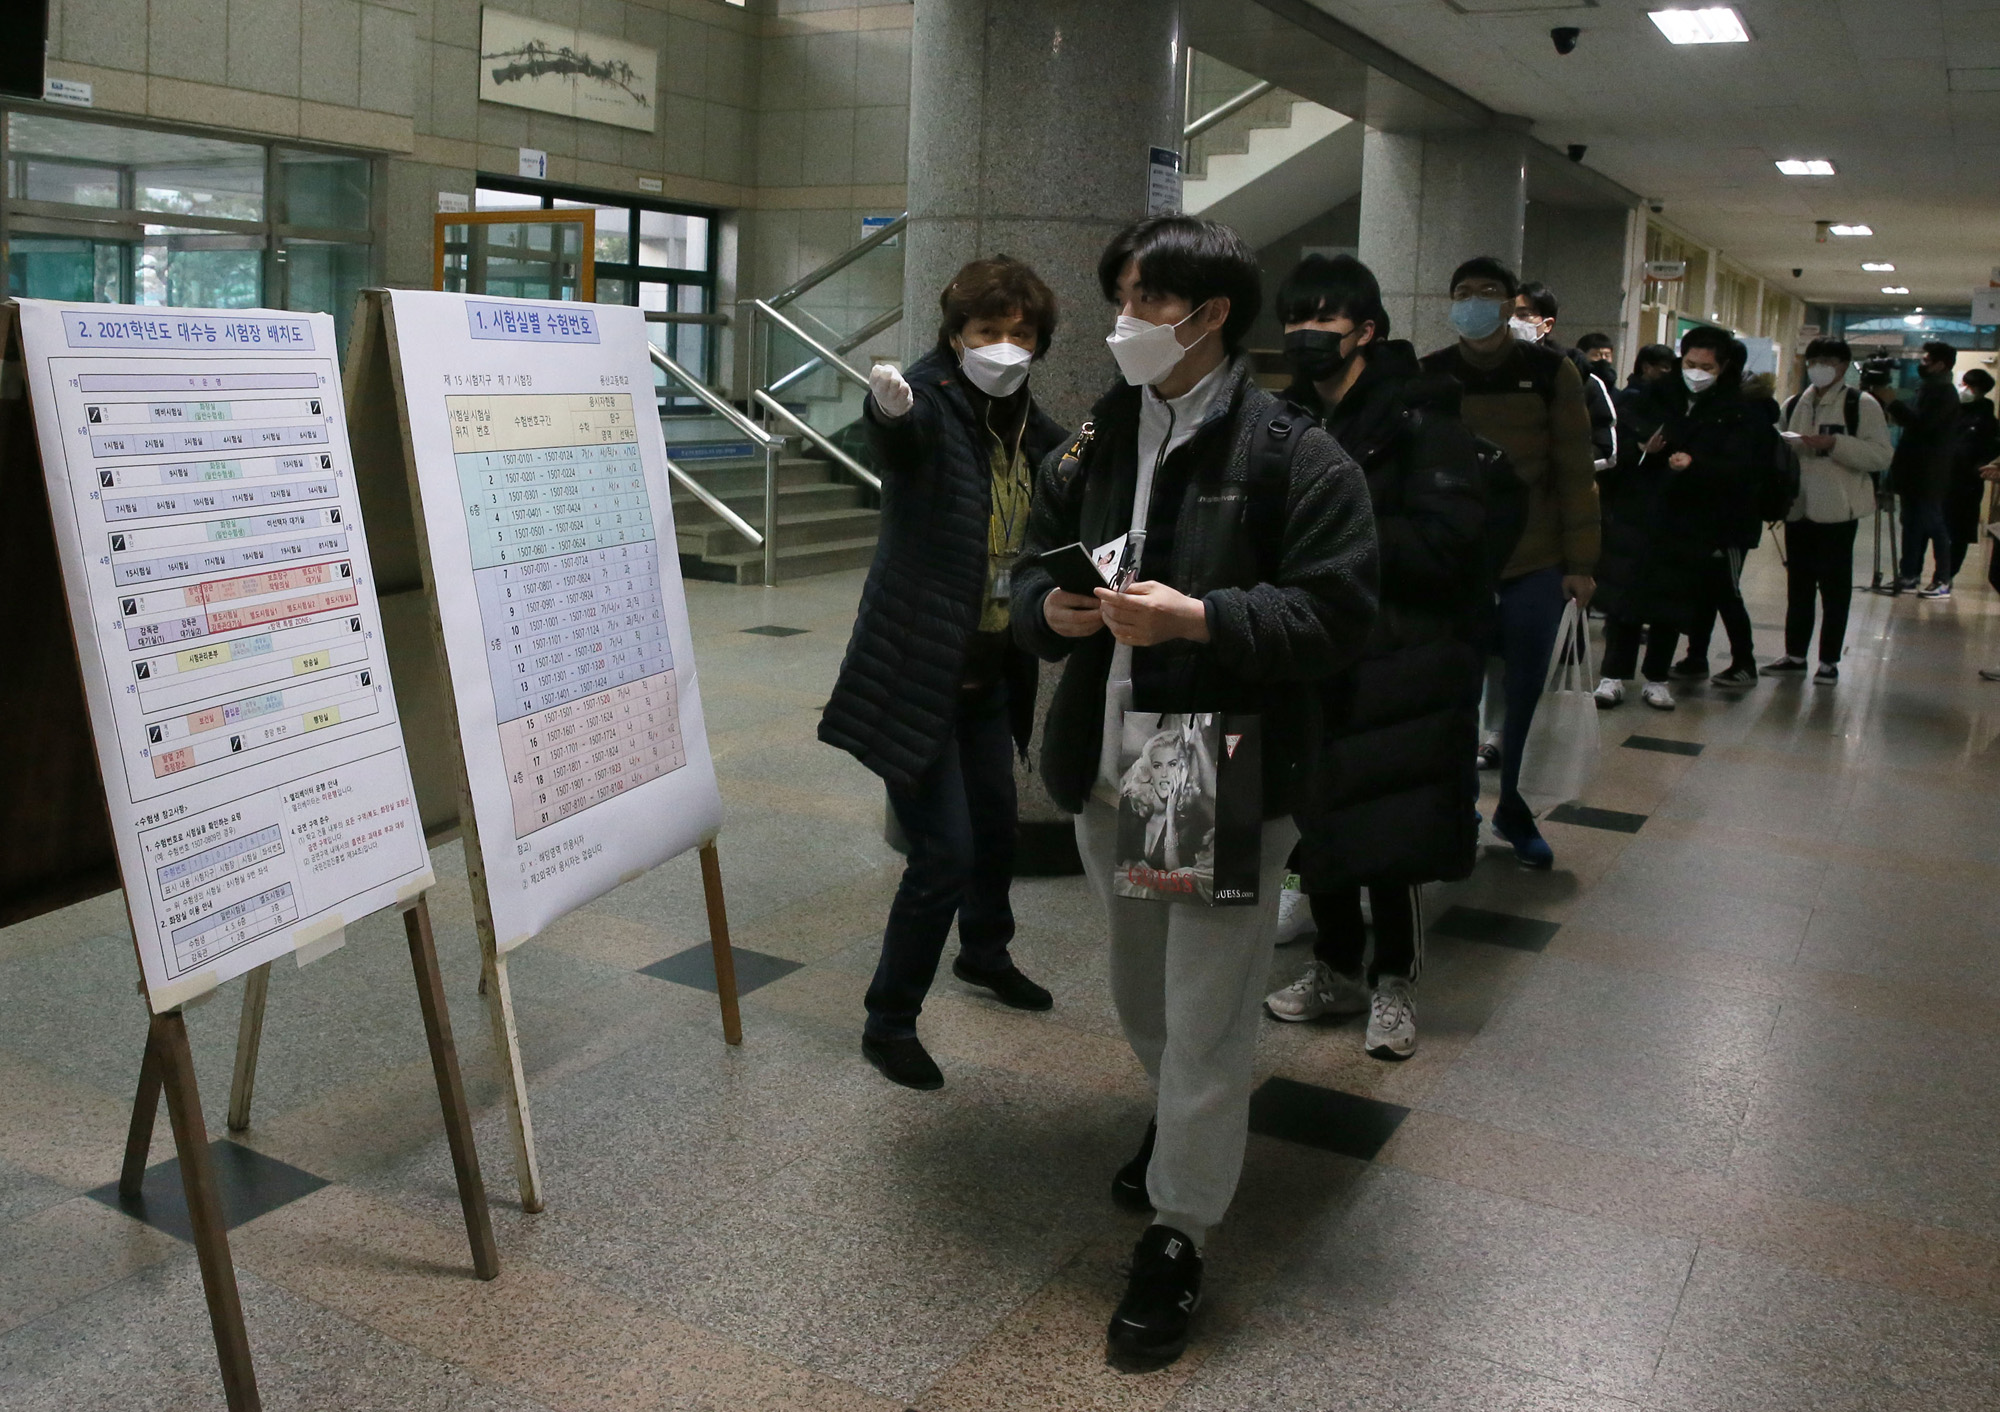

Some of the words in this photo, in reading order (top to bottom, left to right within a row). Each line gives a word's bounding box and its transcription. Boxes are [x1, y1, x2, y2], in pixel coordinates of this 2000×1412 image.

[476, 311, 487, 330] 1.
[493, 309, 541, 334] 시험실별
[546, 313, 592, 335] 수험번호
[79, 321, 92, 339] 2.
[98, 320, 172, 342] 2021학년도
[177, 322, 217, 343] 대수능
[225, 323, 261, 343] 시험장
[267, 324, 303, 343] 배치도
[443, 374, 451, 386] 제
[454, 375, 462, 386] 15
[466, 374, 491, 387] 시험지구
[514, 374, 532, 387] 시험장
[450, 409, 469, 422] 시험실
[470, 409, 491, 422] 시험실
[514, 415, 551, 428] 수험번호구간
[262, 432, 281, 441] 5시험실
[299, 430, 317, 439] 6시험실
[455, 425, 469, 438] 위치
[476, 425, 490, 437] 번호
[104, 441, 125, 450] 1시험실
[145, 439, 164, 448] 2시험실
[184, 437, 203, 446] 3시험실
[223, 435, 242, 444] 4시험실
[283, 459, 303, 468] 13시험실
[503, 453, 533, 465] 1507-0101
[545, 450, 573, 462] 1507-0124
[169, 468, 188, 478] 9시험실
[506, 471, 535, 483] 1507-0201
[547, 468, 576, 480] 1507-0224
[270, 489, 291, 498] 12시험실
[308, 485, 328, 494] 14시험실
[509, 489, 538, 502] 1507-0301
[550, 485, 578, 497] 1507-0324
[193, 497, 214, 506] 10시험실
[232, 492, 254, 502] 11시험실
[116, 503, 137, 514] 7시험실
[156, 500, 176, 510] 8시험실
[469, 504, 480, 516] 6층
[512, 508, 541, 520] 1507-0401
[553, 503, 581, 515] 1507-0424
[515, 526, 544, 539] 1507-0501
[556, 520, 583, 533] 1507-0524
[281, 545, 302, 555] 19시험실
[318, 539, 338, 549] 81시험실
[517, 544, 547, 558] 1507-0601
[559, 538, 586, 551] 1507-0624
[204, 556, 226, 566] 17시험실
[242, 550, 264, 560] 18시험실
[125, 566, 151, 578] 15시험실
[168, 561, 189, 571] 16시험실
[520, 562, 550, 576] 1507-0701
[561, 555, 588, 569] 1507-0724
[523, 580, 552, 594] 1507-0801
[563, 573, 591, 586] 1507-0824
[526, 598, 556, 613] 1507-0901
[566, 590, 593, 604] 1507-0924
[181, 618, 197, 628] 감독관
[512, 625, 519, 636] 10
[529, 616, 559, 631] 1507-1001
[569, 607, 596, 622] 1507-1022
[140, 625, 159, 636] 감독관
[138, 635, 165, 646] 대기실(1)
[491, 638, 501, 651] 5층
[515, 644, 522, 654] 11
[532, 634, 561, 650] 1507-1101
[572, 625, 600, 640] 1507-1124
[189, 649, 218, 663] 시험관리본부
[303, 657, 319, 668] 방송실
[518, 663, 525, 673] 12
[535, 652, 564, 668] 1507-1201
[575, 642, 603, 657] 1507-1220
[521, 682, 528, 692] 13
[538, 670, 567, 687] 1507-1301
[577, 659, 605, 675] 1507-1320
[524, 700, 531, 711] 14
[541, 688, 570, 705] 1507-1401
[580, 676, 607, 693] 1507-1424
[527, 719, 534, 729] 15
[544, 706, 573, 723] 1507-1501
[583, 694, 610, 710] 1507-1520
[199, 714, 214, 725] 보건실
[313, 713, 329, 724] 행정실
[530, 737, 537, 748] 16
[547, 724, 576, 742] 1507-1601
[586, 711, 613, 728] 1507-1624
[533, 756, 540, 767] 17
[550, 742, 578, 760] 1507-1701
[589, 728, 616, 745] 1507-1724
[536, 775, 544, 785] 18
[553, 760, 581, 778] 1507-1801
[592, 745, 619, 763] 1507-1824
[513, 771, 524, 784] 4층
[539, 793, 546, 804] 19
[556, 777, 584, 797] 1507-1901
[594, 762, 621, 781] 1507-1923
[542, 812, 549, 822] 81
[558, 796, 587, 816] 1507-8101
[597, 780, 623, 798] 1507-8102
[154, 833, 183, 850] 수험번호로
[1128, 865, 1193, 893] GUESS
[161, 920, 168, 928] 2.
[169, 910, 187, 925] 화장실
[189, 905, 200, 916] 이용
[202, 900, 213, 912] 안내
[188, 935, 205, 949] 수험생
[191, 949, 208, 963] 감독관
